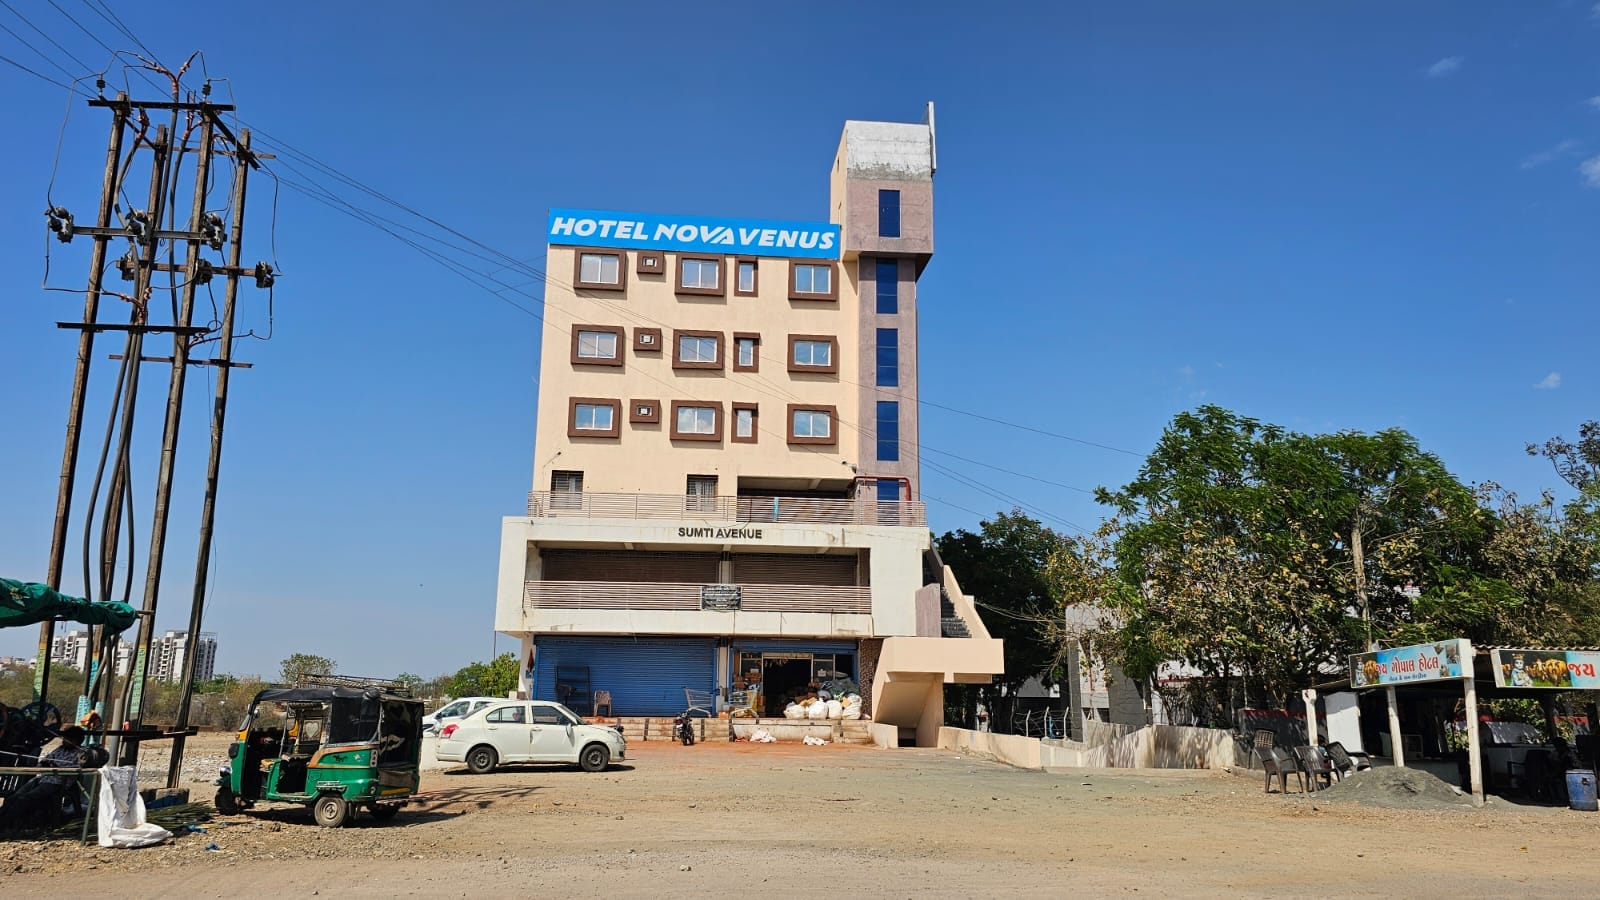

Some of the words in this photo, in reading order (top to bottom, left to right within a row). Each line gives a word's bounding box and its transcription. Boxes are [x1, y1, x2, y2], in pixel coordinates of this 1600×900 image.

[550, 217, 649, 241] HOTEL
[678, 527, 714, 538] SUMTI
[715, 528, 763, 539] AVENUE
[1374, 663, 1388, 675] જય
[1391, 656, 1415, 673] ગોપાલ
[1418, 653, 1439, 671] હોટલ
[1568, 663, 1596, 677] જય
